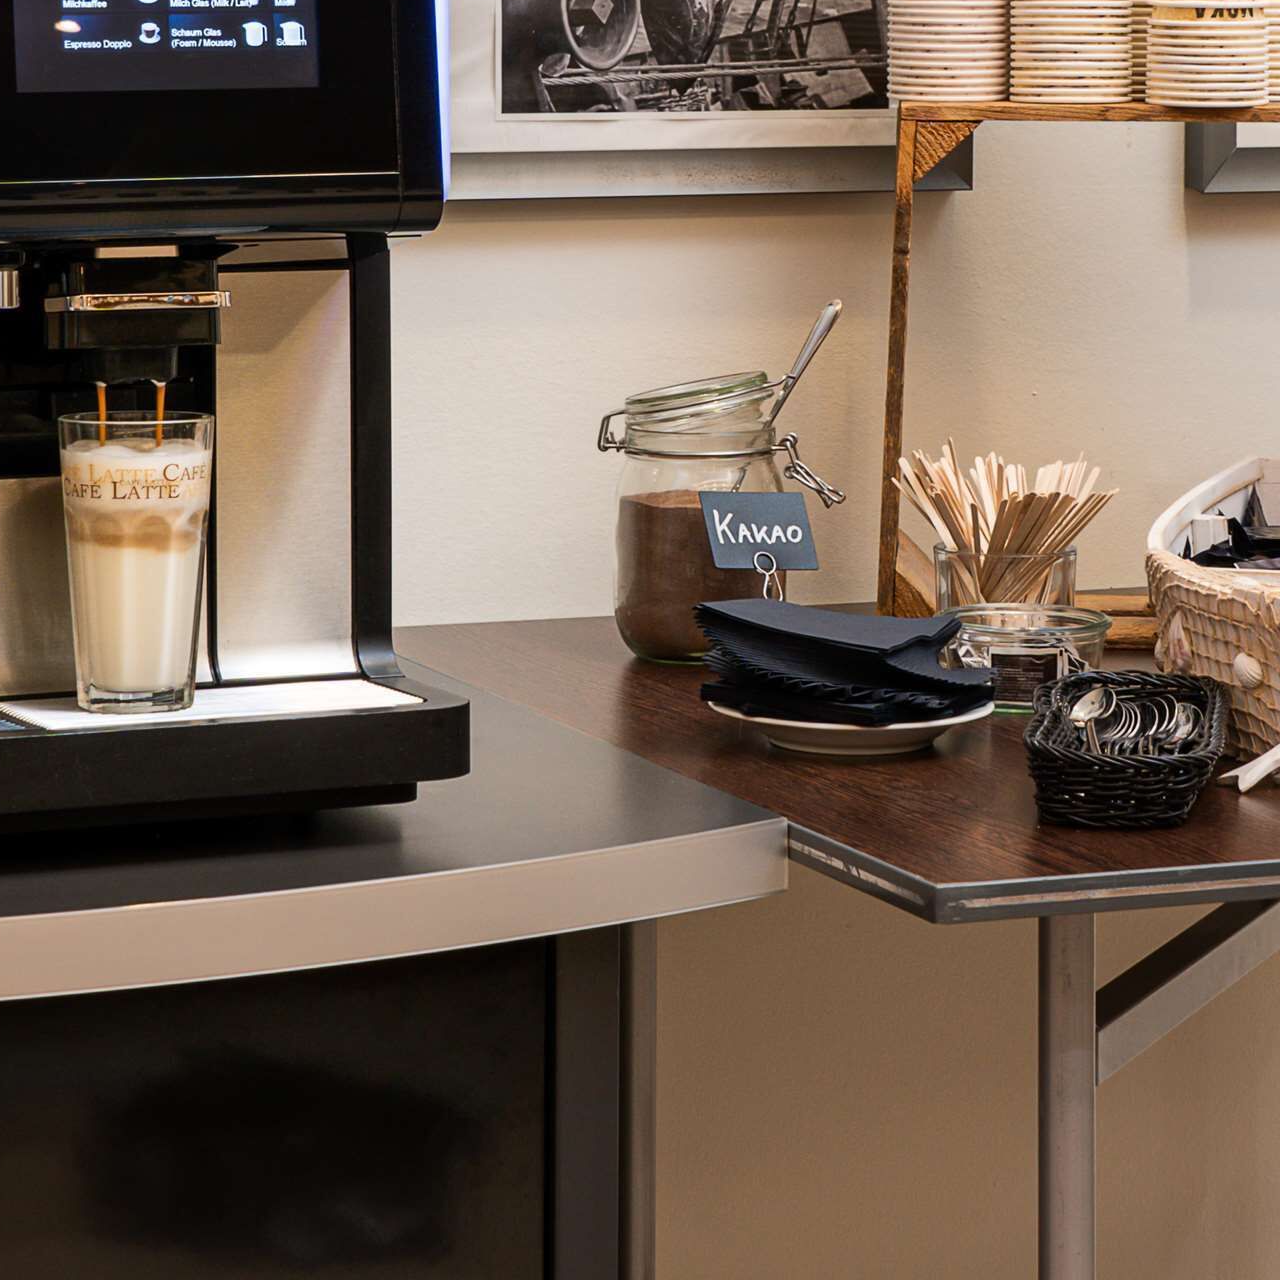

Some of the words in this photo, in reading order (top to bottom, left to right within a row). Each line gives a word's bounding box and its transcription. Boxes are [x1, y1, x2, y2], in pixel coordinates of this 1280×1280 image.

[62, 0, 107, 8] Milchkaffee
[171, 28, 203, 37] Schaum
[204, 28, 222, 37] Glas
[64, 40, 102, 50] Espresso
[103, 40, 133, 50] Doppio
[171, 39, 198, 49] (Foam
[203, 39, 237, 49] Mousse)
[712, 508, 803, 545] KAKAO
